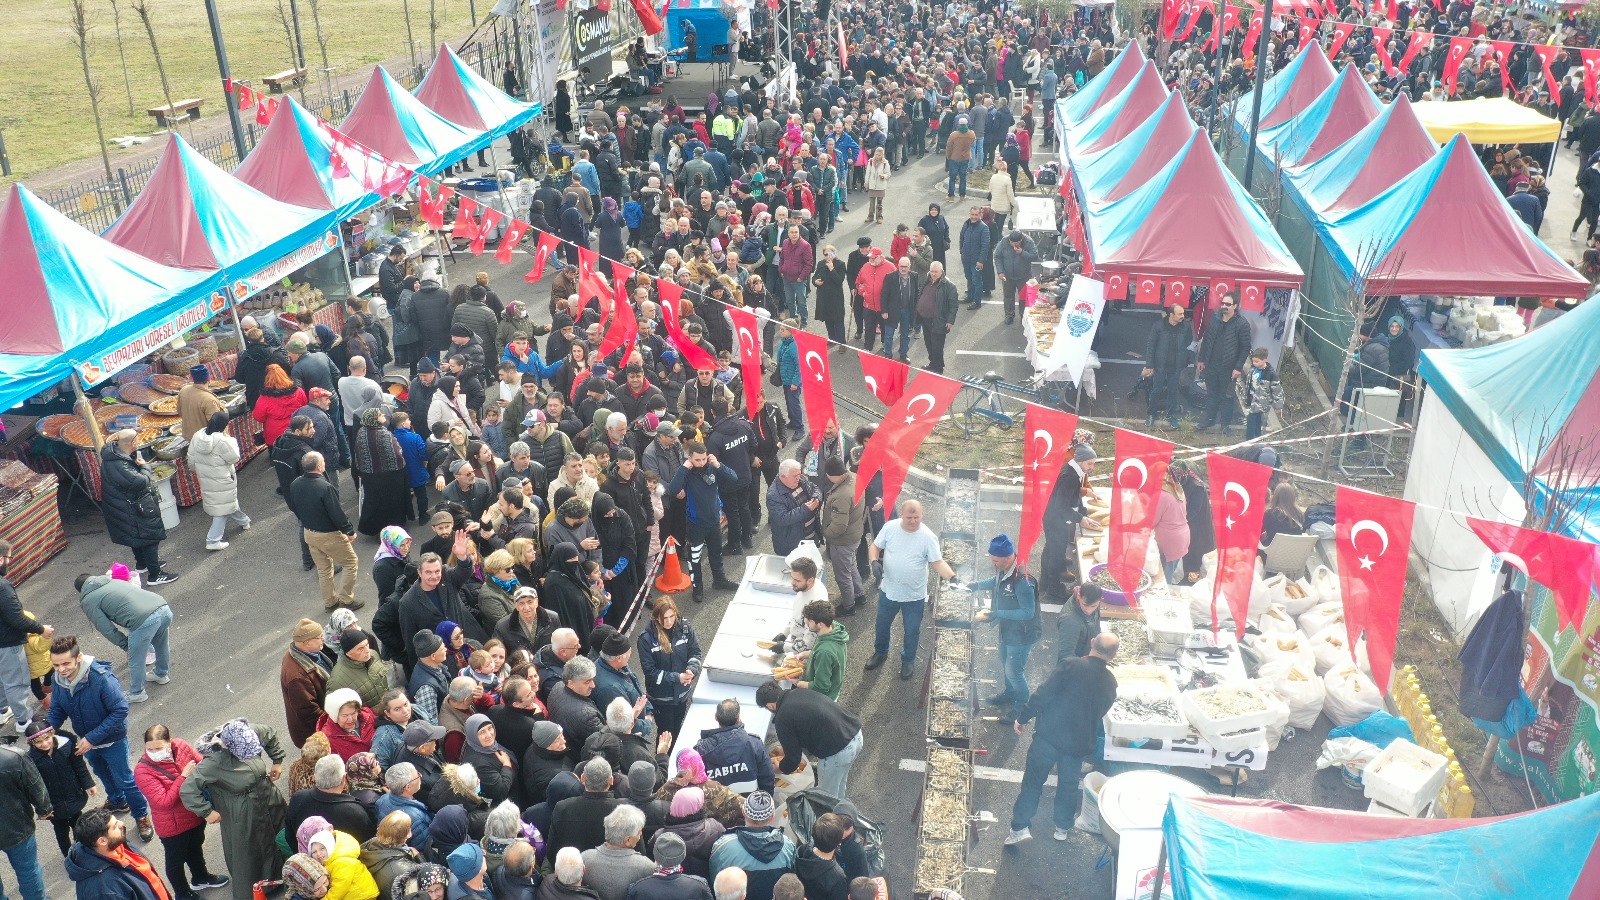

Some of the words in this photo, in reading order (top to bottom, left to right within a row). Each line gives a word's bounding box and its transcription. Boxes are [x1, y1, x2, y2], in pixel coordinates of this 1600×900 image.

[102, 337, 144, 373] BEYPAZARI
[144, 320, 175, 349] YÖRESEL
[725, 435, 748, 450] ZABITA
[706, 762, 749, 779] ZABITA
